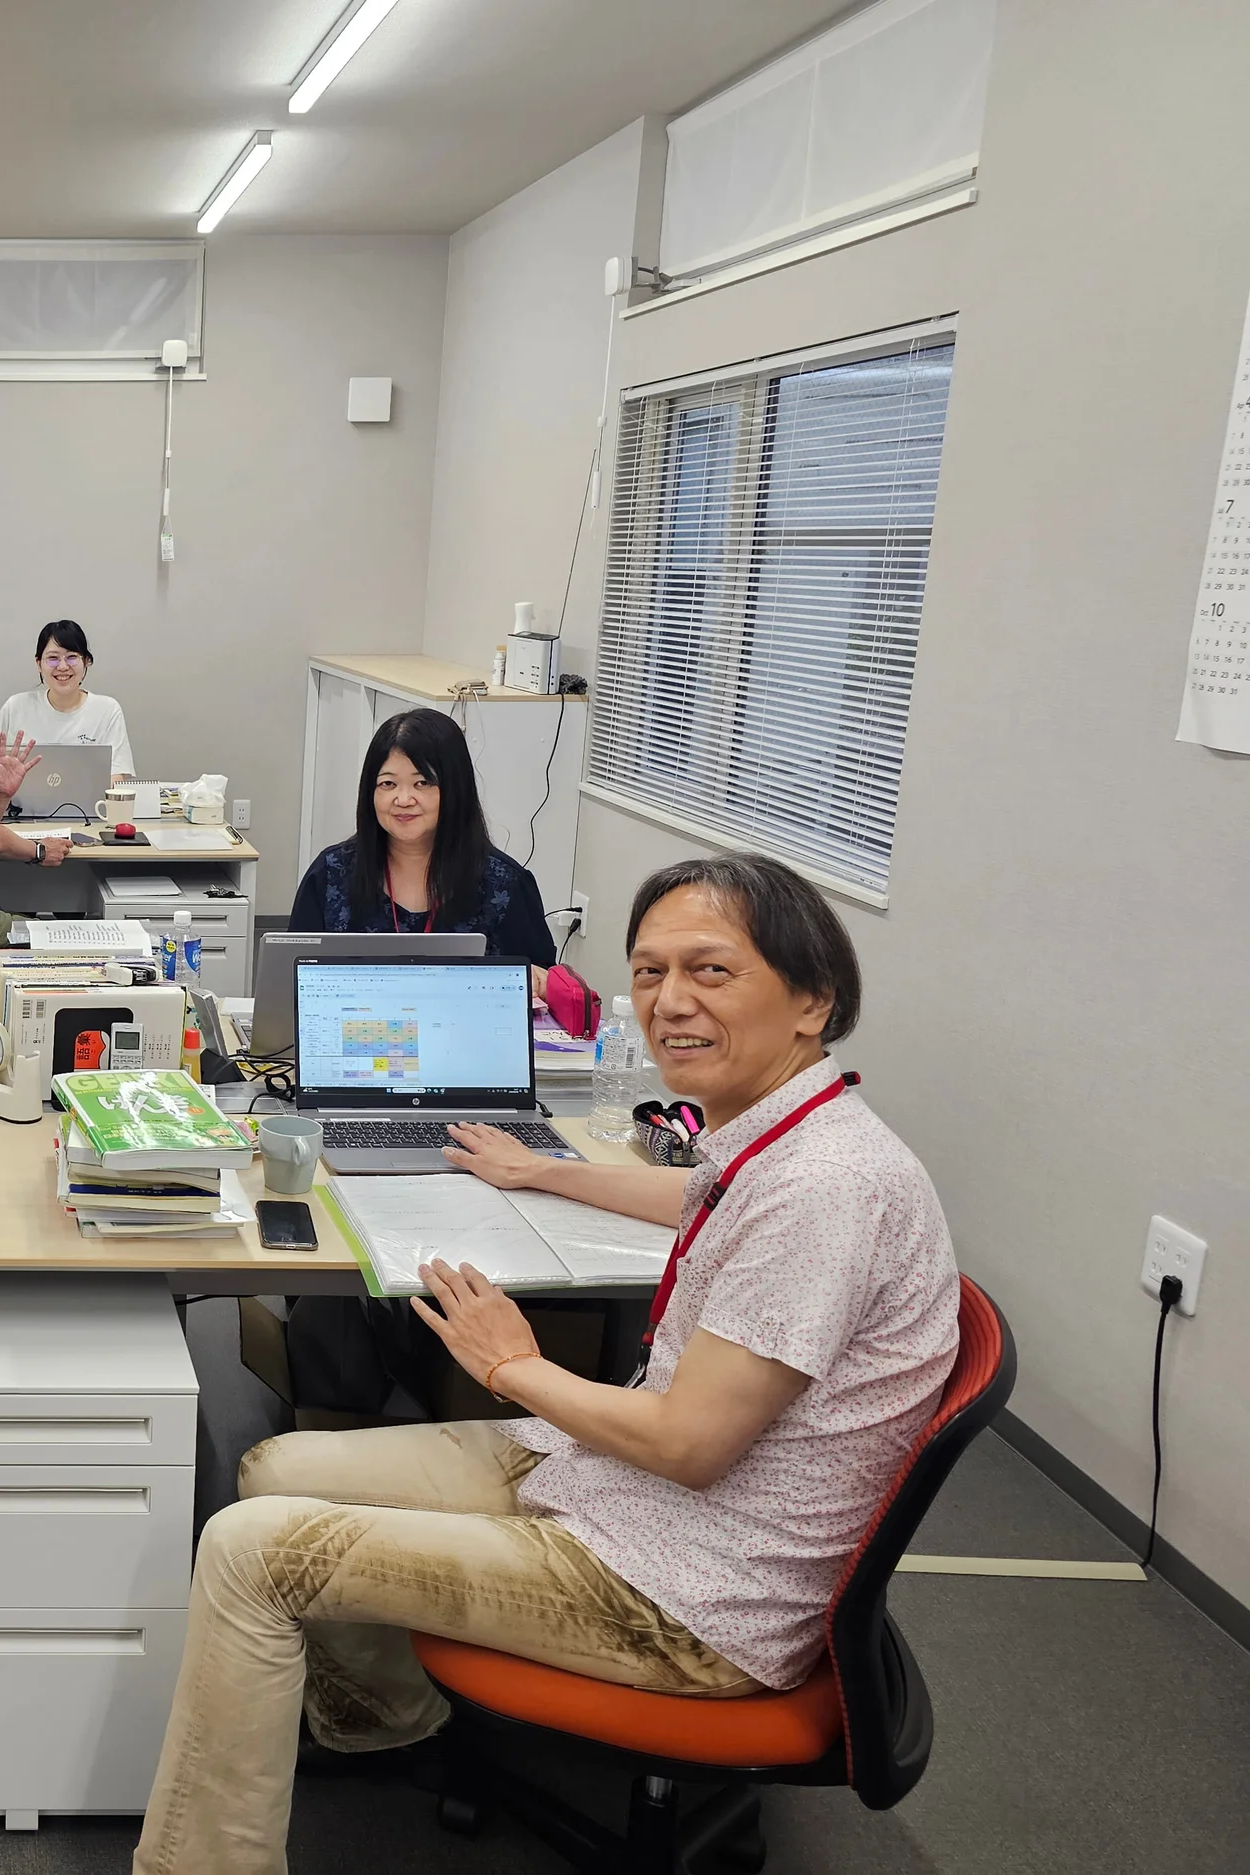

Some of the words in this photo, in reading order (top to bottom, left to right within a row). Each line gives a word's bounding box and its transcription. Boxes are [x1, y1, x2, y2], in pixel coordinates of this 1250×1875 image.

[1224, 499, 1235, 514] 7
[1216, 567, 1226, 575] 22
[1240, 568, 1249, 576] 24
[1213, 582, 1223, 590] 29
[1225, 583, 1235, 591] 30
[1237, 583, 1246, 591] 31
[1210, 602, 1225, 617] 10
[1224, 656, 1233, 664] 16
[1236, 657, 1246, 665] 17
[1209, 670, 1218, 678] 22
[1220, 671, 1229, 679] 23
[1232, 672, 1242, 680] 24
[1206, 685, 1215, 693] 29
[1217, 686, 1226, 694] 30
[1229, 687, 1238, 695] 31
[47, 773, 61, 787] hp
